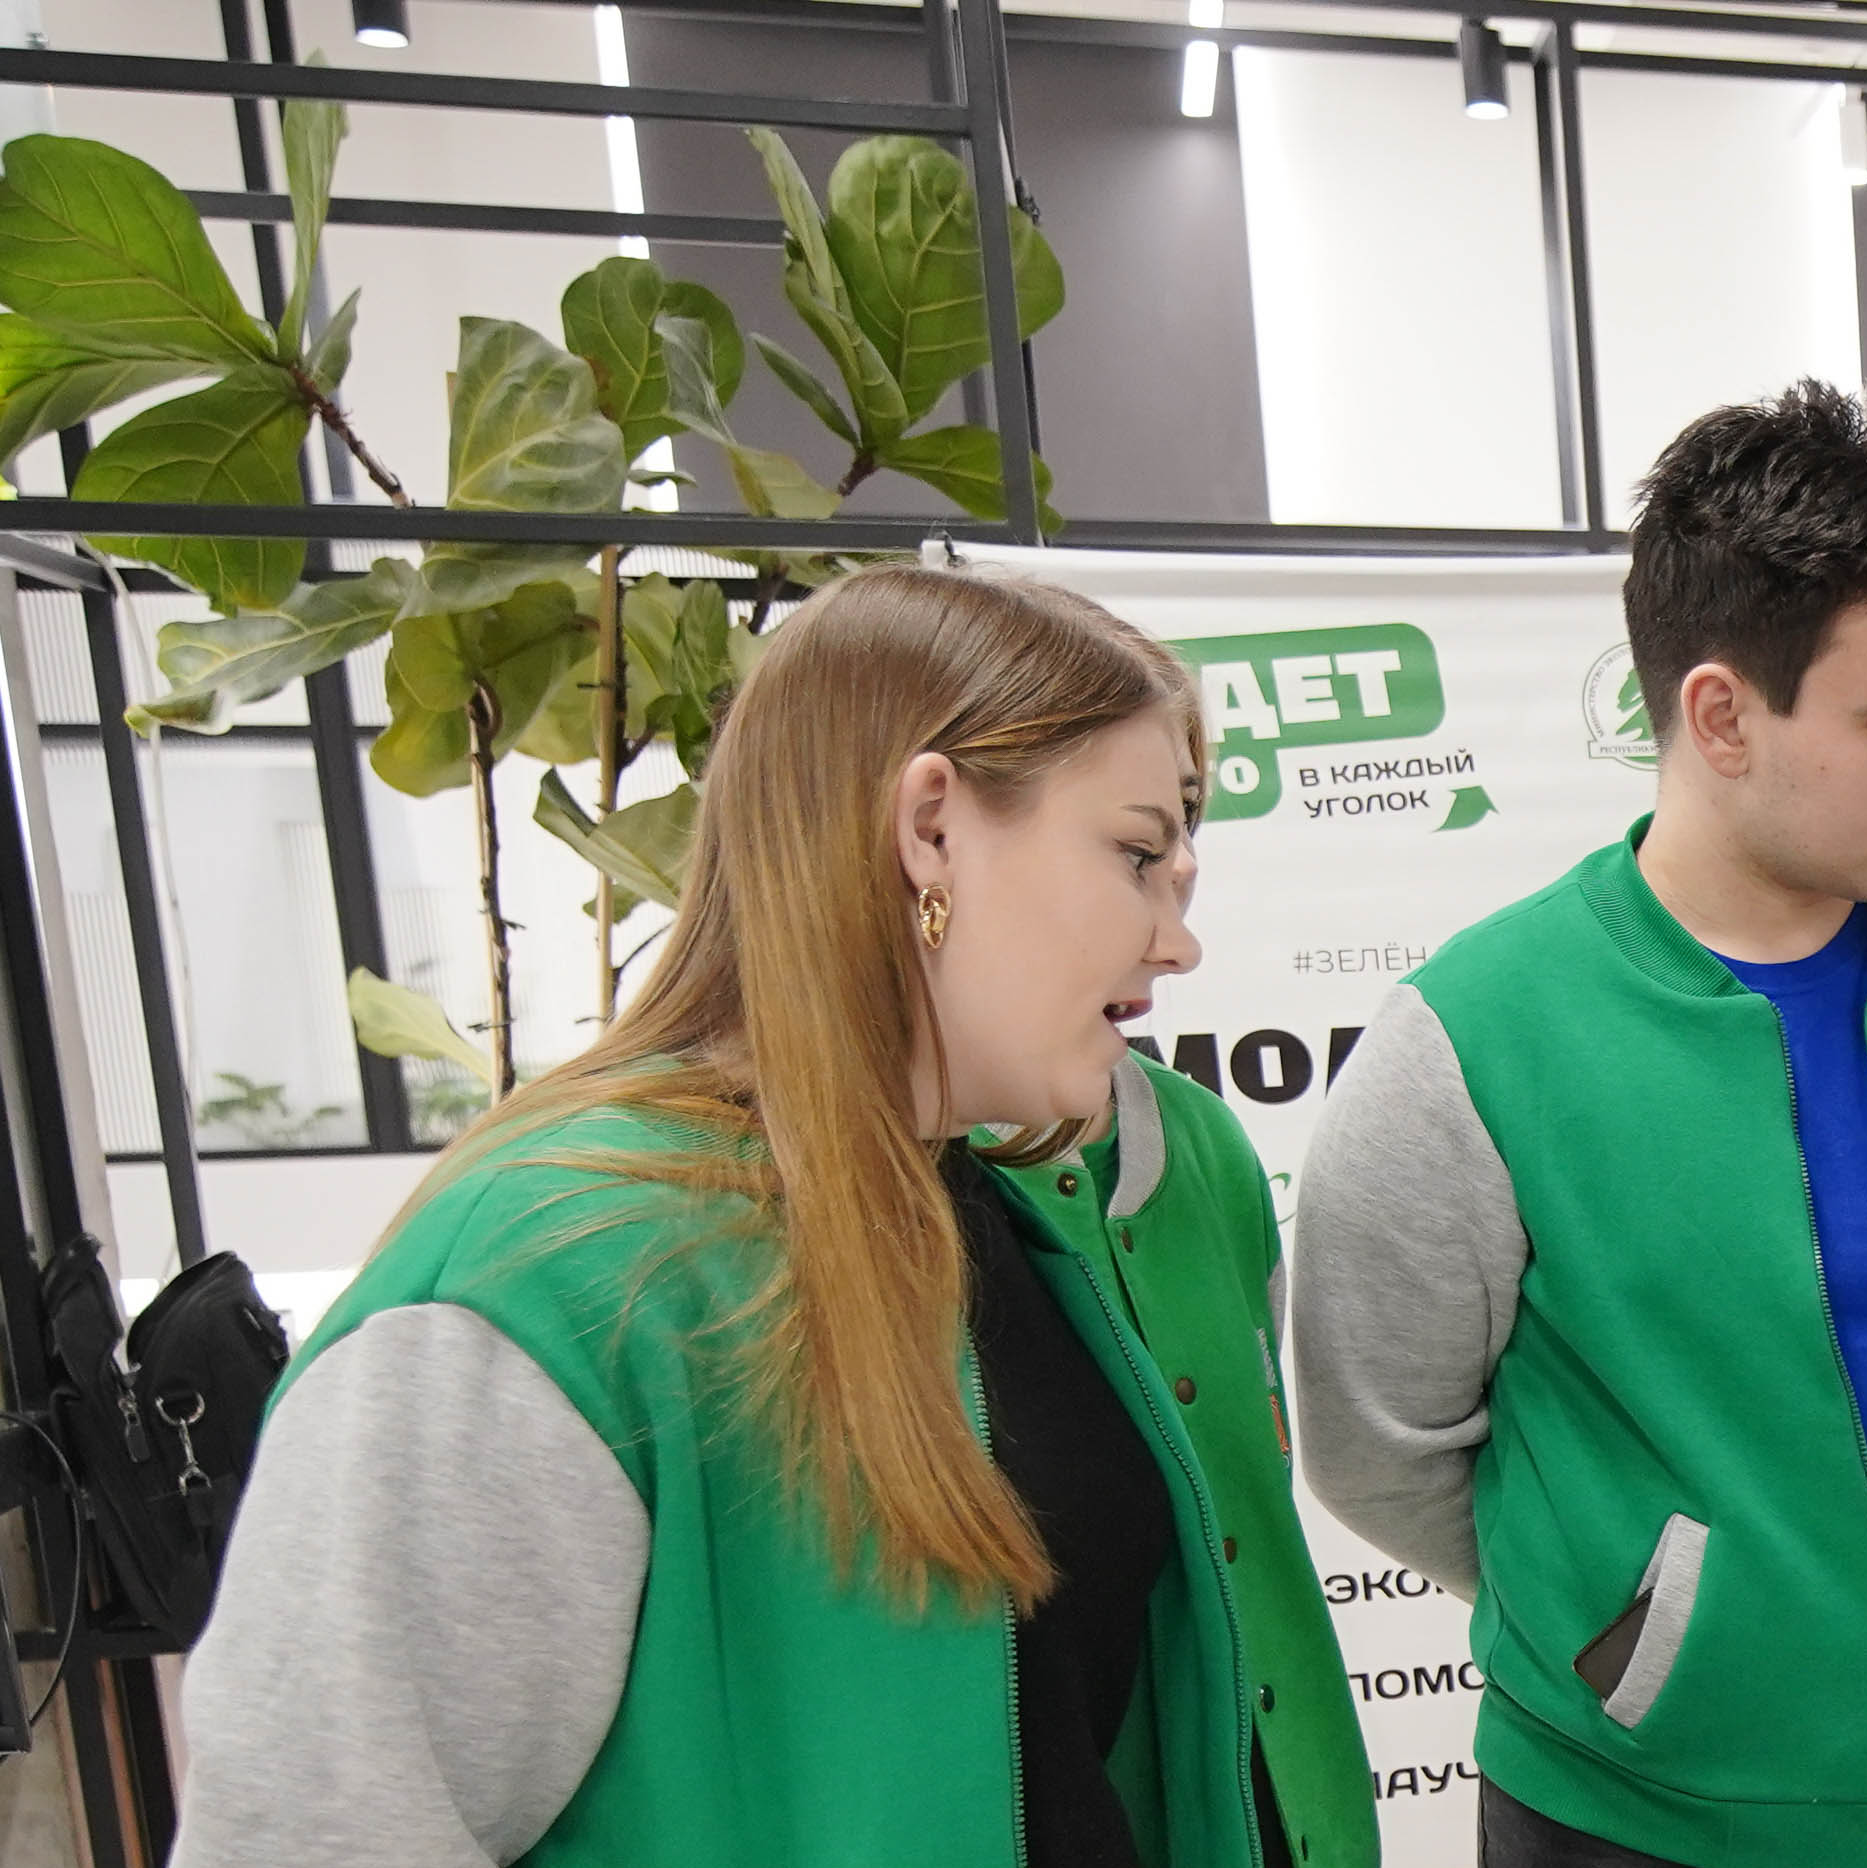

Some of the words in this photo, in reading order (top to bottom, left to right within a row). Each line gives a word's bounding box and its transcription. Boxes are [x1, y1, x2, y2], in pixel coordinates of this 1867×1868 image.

[1300, 768, 1319, 787] В
[1331, 749, 1475, 785] КАЖДЫЙ
[1304, 789, 1430, 819] УГОЛОК
[1325, 1568, 1444, 1605] ЭКО
